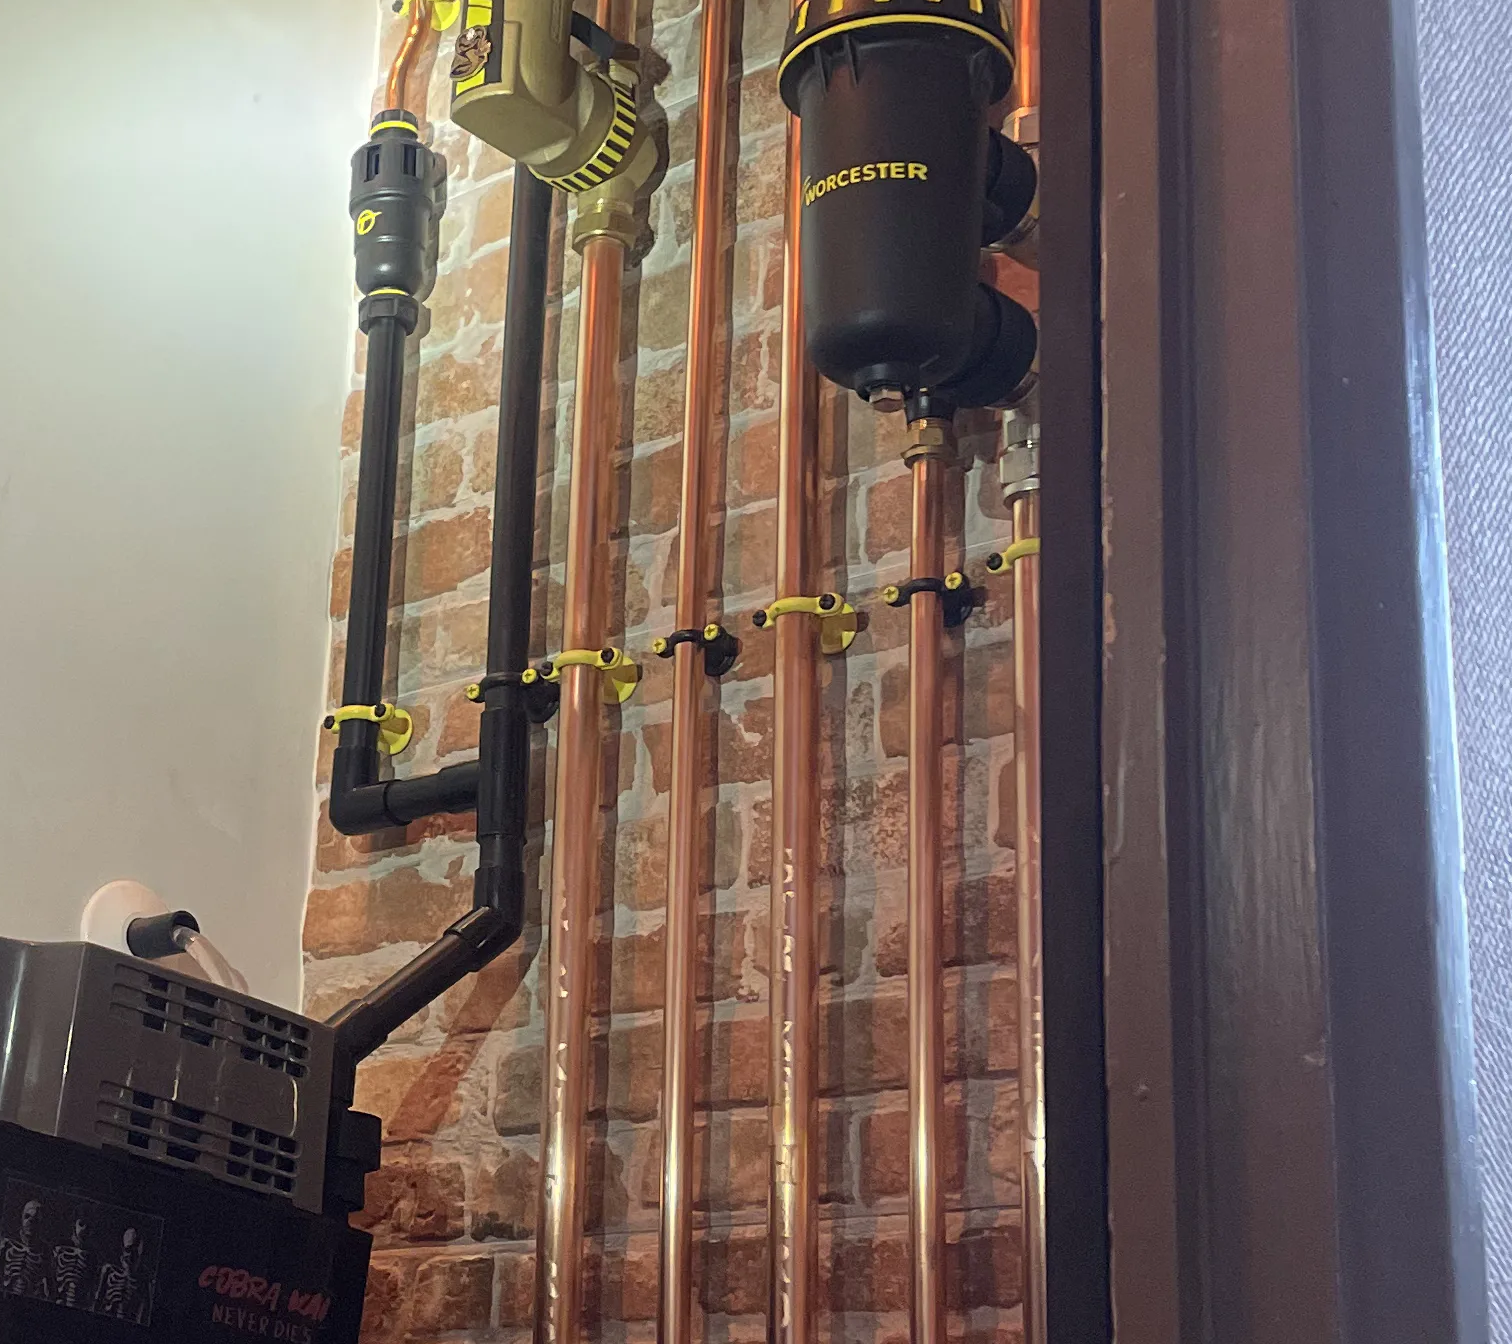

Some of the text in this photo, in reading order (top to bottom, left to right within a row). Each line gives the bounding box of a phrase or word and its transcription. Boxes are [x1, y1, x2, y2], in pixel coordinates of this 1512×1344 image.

[804, 161, 929, 207] WORCESTER
[197, 1265, 282, 1312] COBRA
[211, 1302, 270, 1337] NEVER
